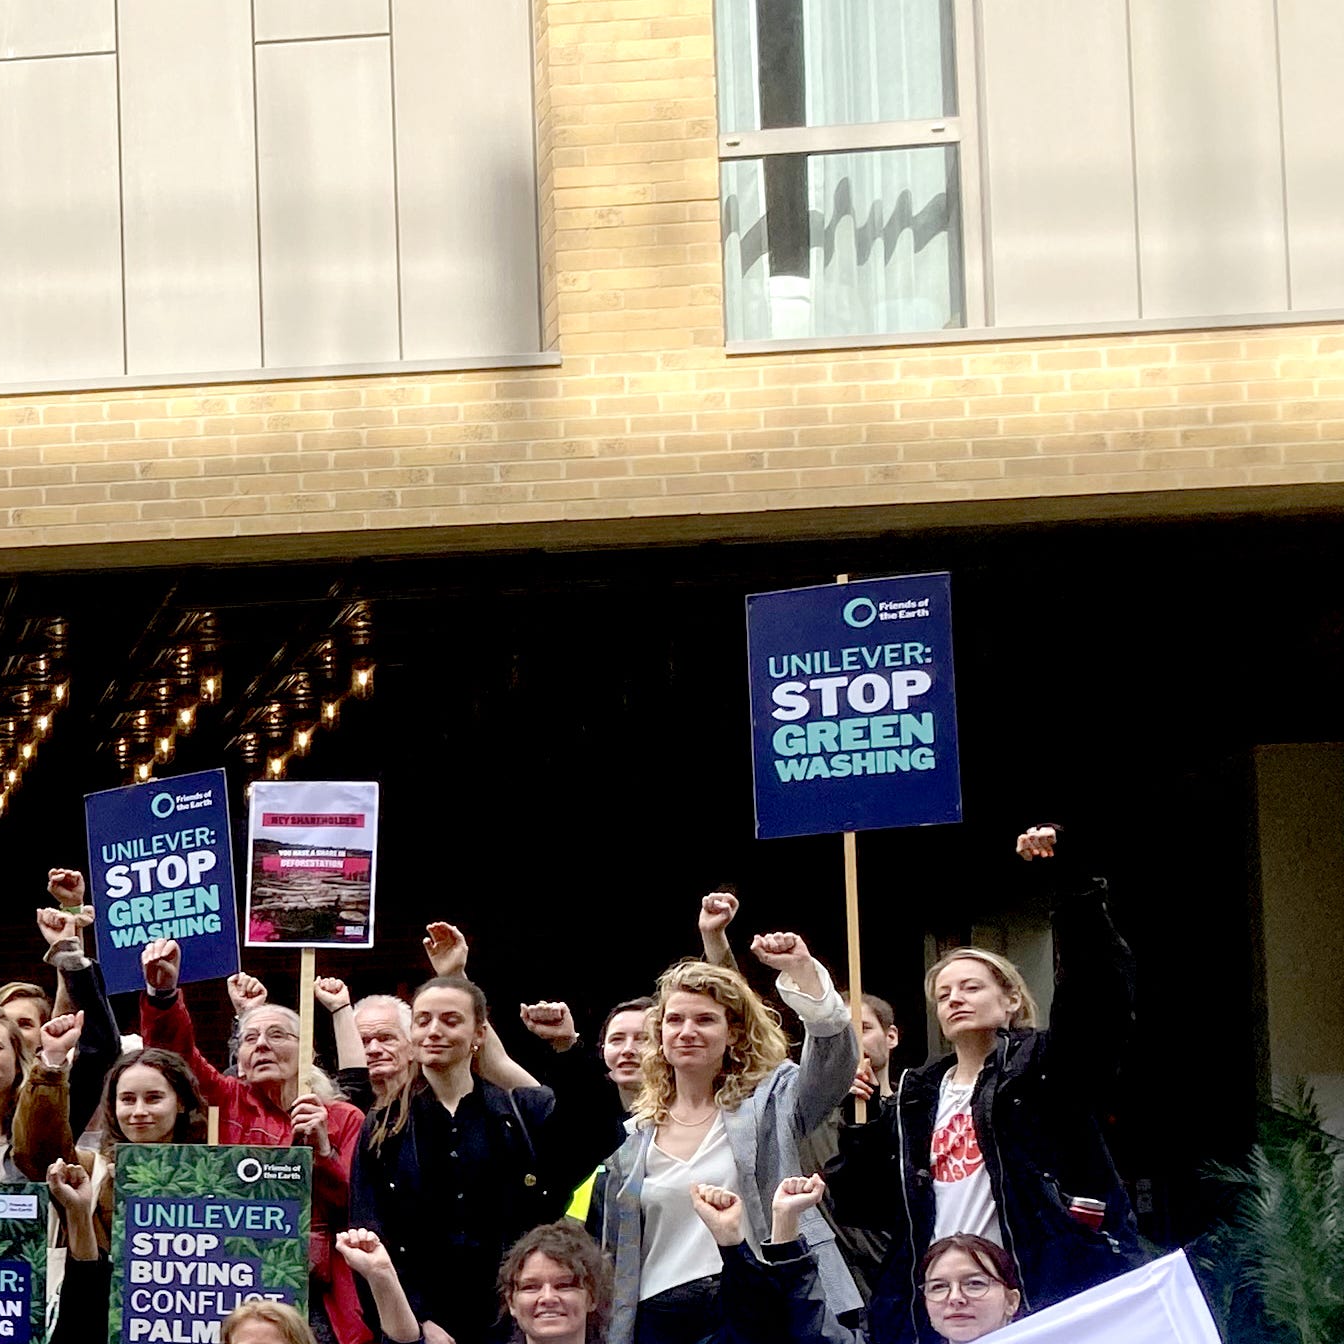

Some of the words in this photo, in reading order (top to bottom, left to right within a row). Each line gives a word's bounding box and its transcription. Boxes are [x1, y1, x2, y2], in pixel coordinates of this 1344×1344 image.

[879, 599, 917, 611] Friends
[918, 598, 929, 607] of
[879, 611, 897, 621] the
[898, 608, 929, 619] Earth
[768, 642, 933, 679] UNILEVER:
[771, 670, 932, 722] STOP
[772, 711, 935, 757] GREEN
[774, 747, 936, 783] WASHING
[175, 793, 203, 804] Friends
[203, 789, 213, 799] of
[176, 801, 190, 812] the
[190, 798, 213, 810] Earth
[101, 826, 217, 865] UNILEVER:
[278, 849, 292, 857] YOU
[105, 849, 217, 900] STOP
[279, 858, 344, 868] DEFORESTATION
[107, 884, 221, 929] GREEN
[109, 913, 222, 949] WASHING
[264, 1163, 291, 1172] Friends
[292, 1164, 301, 1172] of
[264, 1171, 277, 1179] the
[278, 1172, 301, 1180] Earth
[133, 1203, 291, 1235] UNILEVER,
[131, 1232, 219, 1257] STOP
[130, 1260, 254, 1287] BUYING
[129, 1318, 222, 1344] PALM
